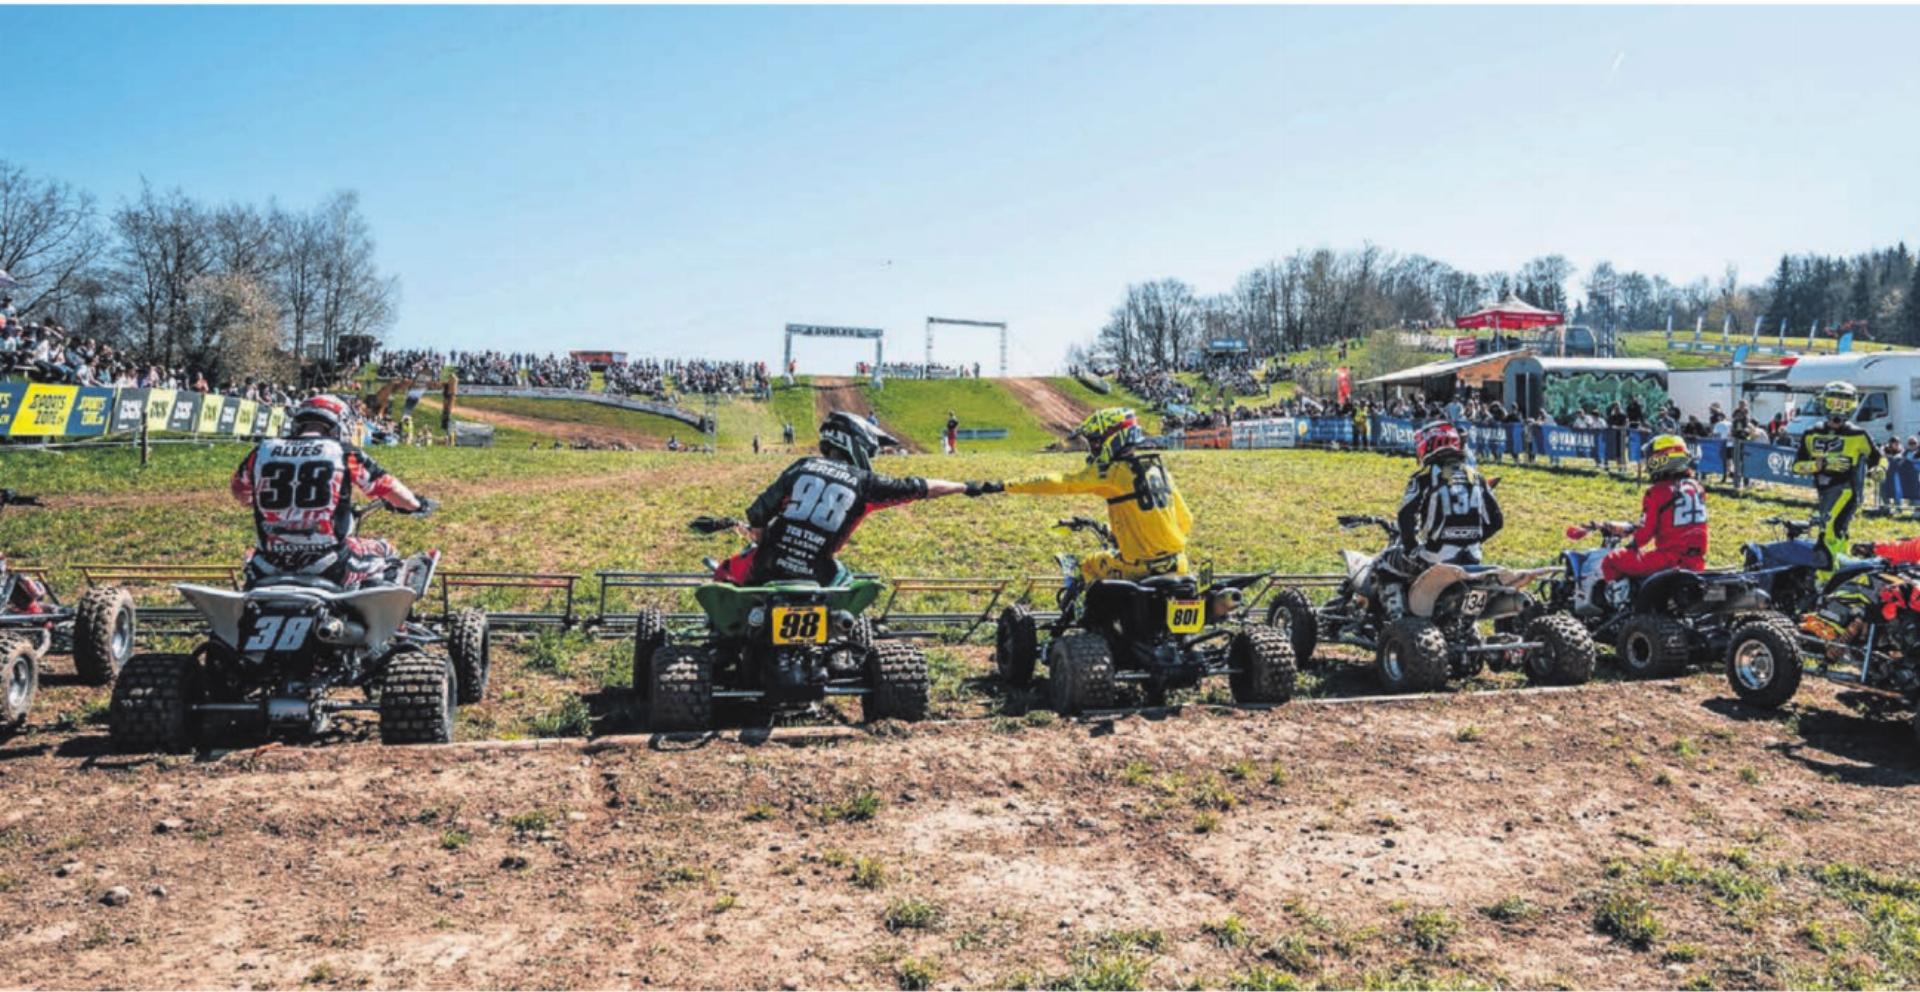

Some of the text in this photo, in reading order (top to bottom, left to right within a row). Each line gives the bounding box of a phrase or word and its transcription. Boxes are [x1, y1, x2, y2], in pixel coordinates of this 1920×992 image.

[271, 444, 323, 457] ALVES
[258, 461, 335, 509] 38
[783, 474, 856, 533] 98
[1461, 590, 1487, 611] 134
[779, 613, 820, 639] 98
[1173, 608, 1199, 626] 801
[244, 615, 313, 651] 38
